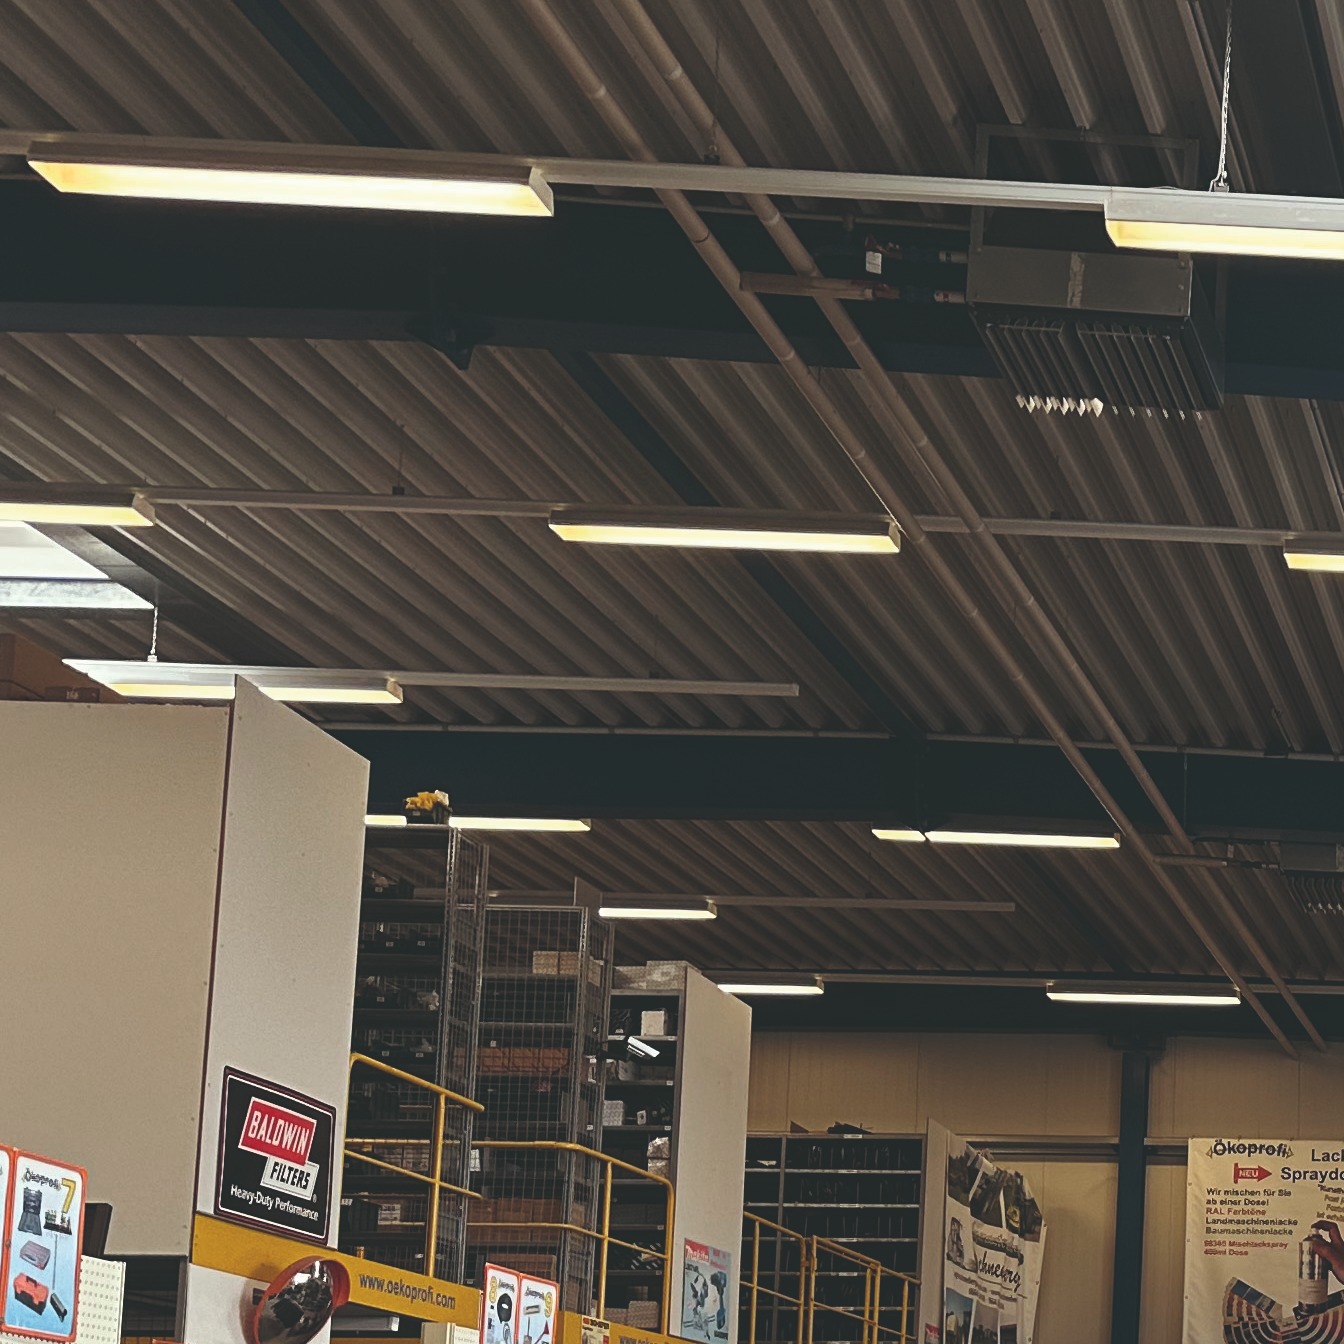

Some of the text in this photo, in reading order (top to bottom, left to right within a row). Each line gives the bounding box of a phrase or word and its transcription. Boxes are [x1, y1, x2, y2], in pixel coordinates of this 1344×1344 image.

[247, 1110, 310, 1156] BALDWIN
[1212, 1139, 1288, 1157] Ökoprofi
[269, 1161, 311, 1189] FILTERS
[1239, 1169, 1259, 1178] NEU
[62, 1177, 76, 1213] 7
[230, 1184, 319, 1221] Heavy-Duty Performance
[1206, 1188, 1292, 1197] Wir mischen für Sie
[1206, 1218, 1298, 1226] Landmaschinenlacke
[1227, 1208, 1267, 1216] Farbtöne
[1206, 1227, 1293, 1235] Baumaschinenlacke
[359, 1273, 456, 1310] www.oekoprofi.com
[545, 1291, 553, 1318] 9
